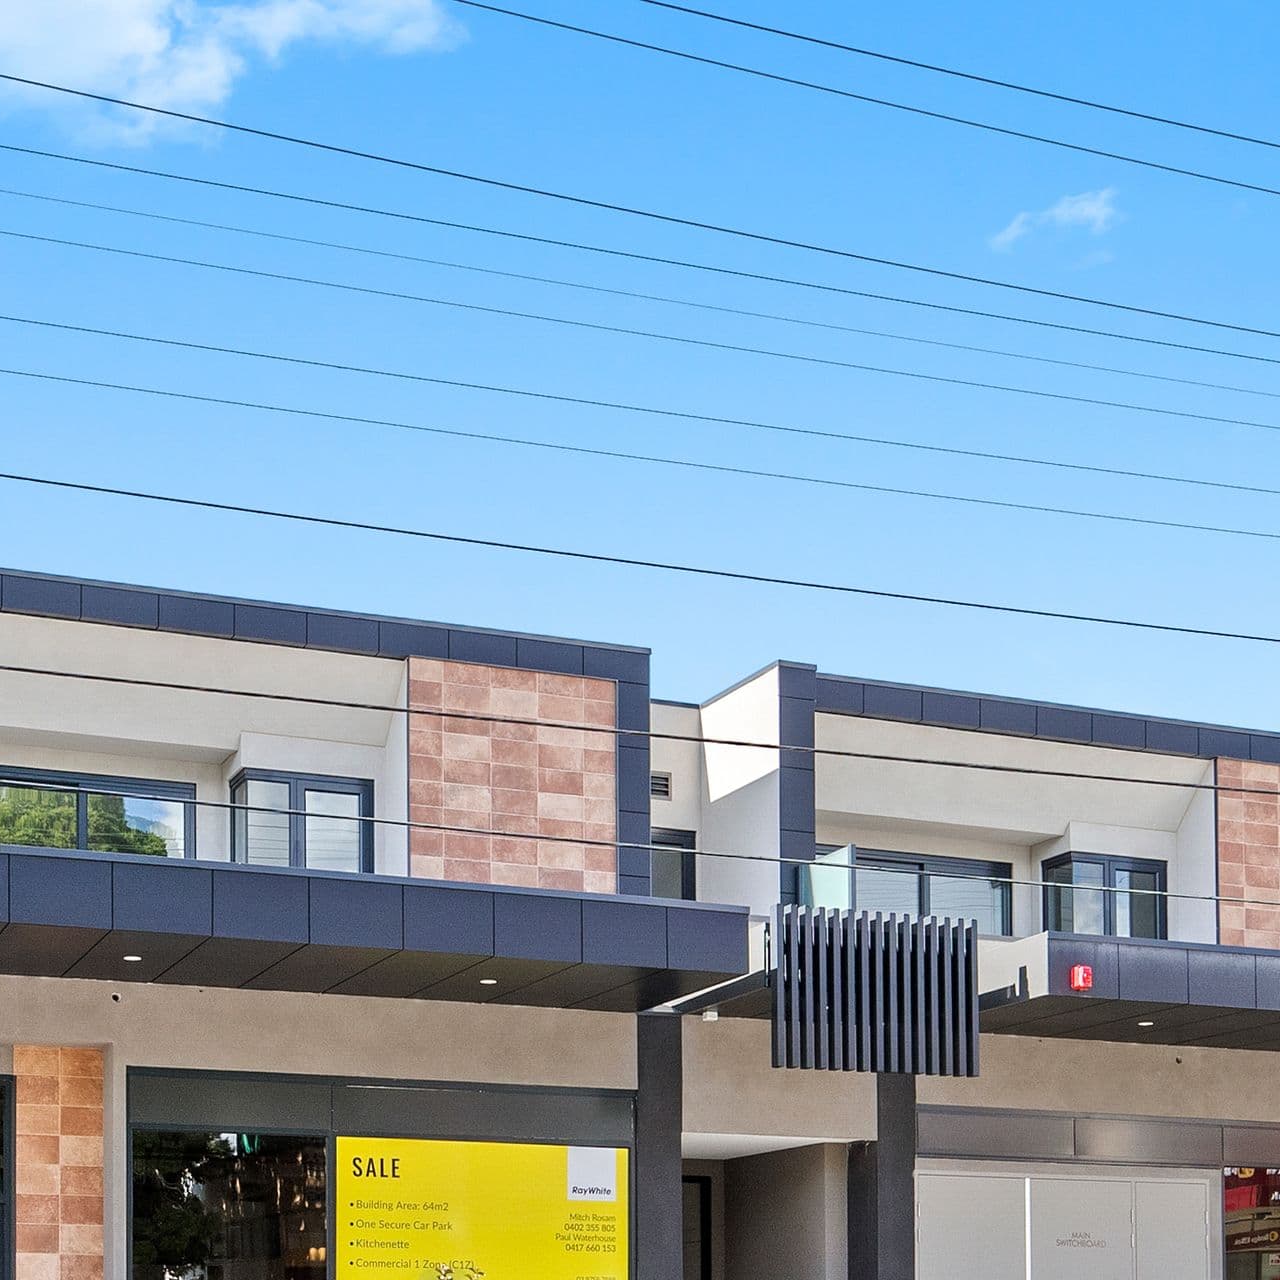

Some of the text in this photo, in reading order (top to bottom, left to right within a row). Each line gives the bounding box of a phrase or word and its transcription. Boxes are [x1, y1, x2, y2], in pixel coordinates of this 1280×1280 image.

[352, 1157, 401, 1178] SALE
[356, 1200, 449, 1211] Building Area: 64m2
[569, 1213, 590, 1221] Mitch
[356, 1219, 453, 1231] One Secure Car Park
[564, 1223, 616, 1232] 0402 355 805
[555, 1233, 616, 1242] Paul Waterhouse
[356, 1238, 410, 1249] Kitchenette
[565, 1244, 616, 1253] 0417 660 153
[356, 1258, 411, 1269] Commercial
[415, 1260, 420, 1269] 1
